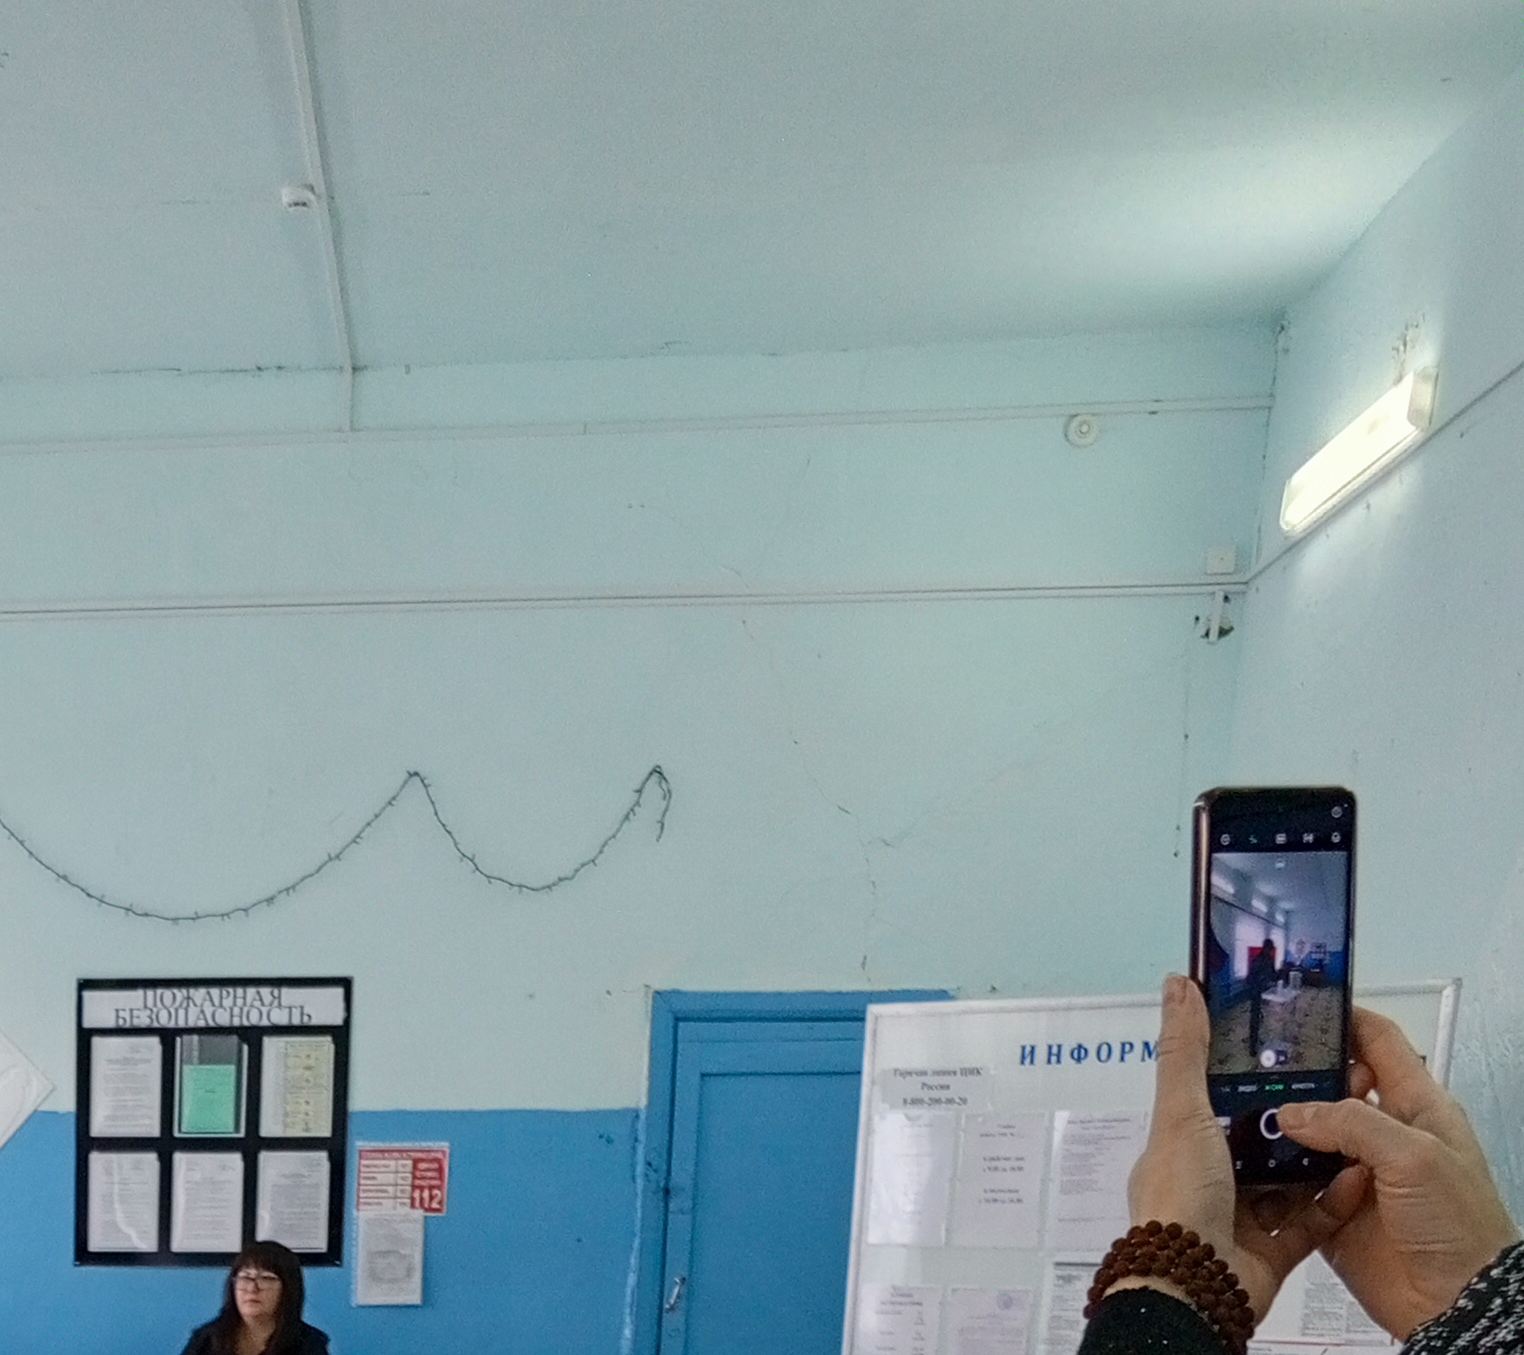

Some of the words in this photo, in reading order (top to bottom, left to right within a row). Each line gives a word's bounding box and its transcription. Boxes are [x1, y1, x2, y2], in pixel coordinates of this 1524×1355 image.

[142, 988, 283, 1009] ПОЖАРНАЯ
[114, 1005, 312, 1028] БЕЗОПАСНОСТЬ
[1018, 1041, 1160, 1066] ИНФОРМ
[412, 1188, 442, 1209] 112
